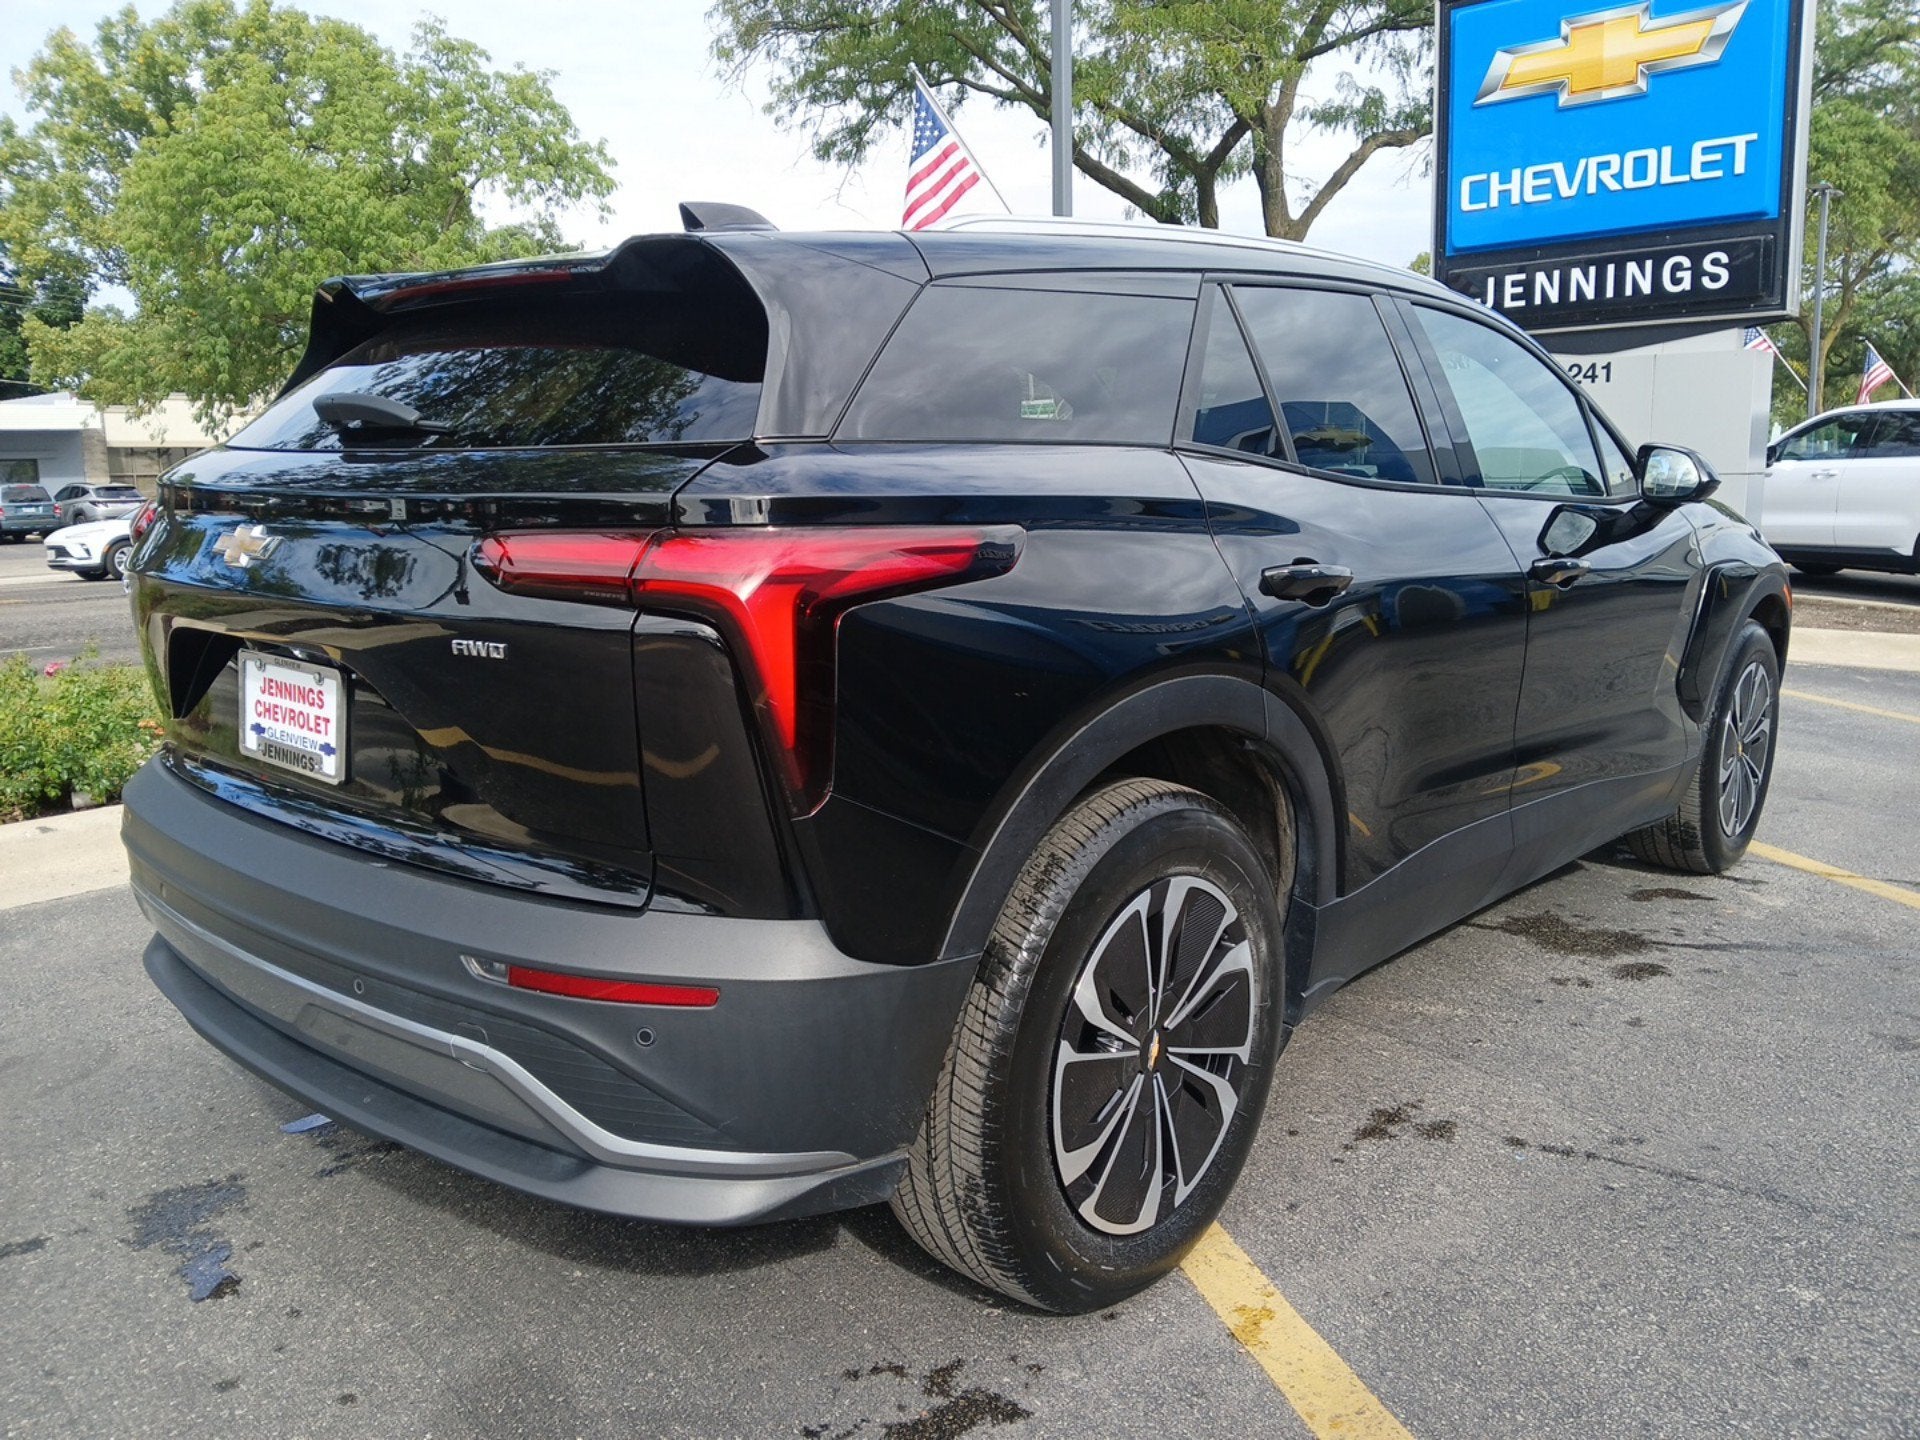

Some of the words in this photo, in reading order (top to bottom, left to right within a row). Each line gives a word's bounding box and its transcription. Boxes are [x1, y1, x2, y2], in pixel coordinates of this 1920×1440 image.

[1460, 132, 1758, 212] CHEVROLET
[1475, 251, 1730, 309] JENNINGS
[1567, 361, 1612, 384] 241
[451, 639, 508, 660] AWD
[260, 677, 325, 710] JENNINGS
[255, 700, 330, 736] CHEVROLET
[267, 726, 318, 751] GLENVIEW
[262, 742, 315, 772] JENNINGS
